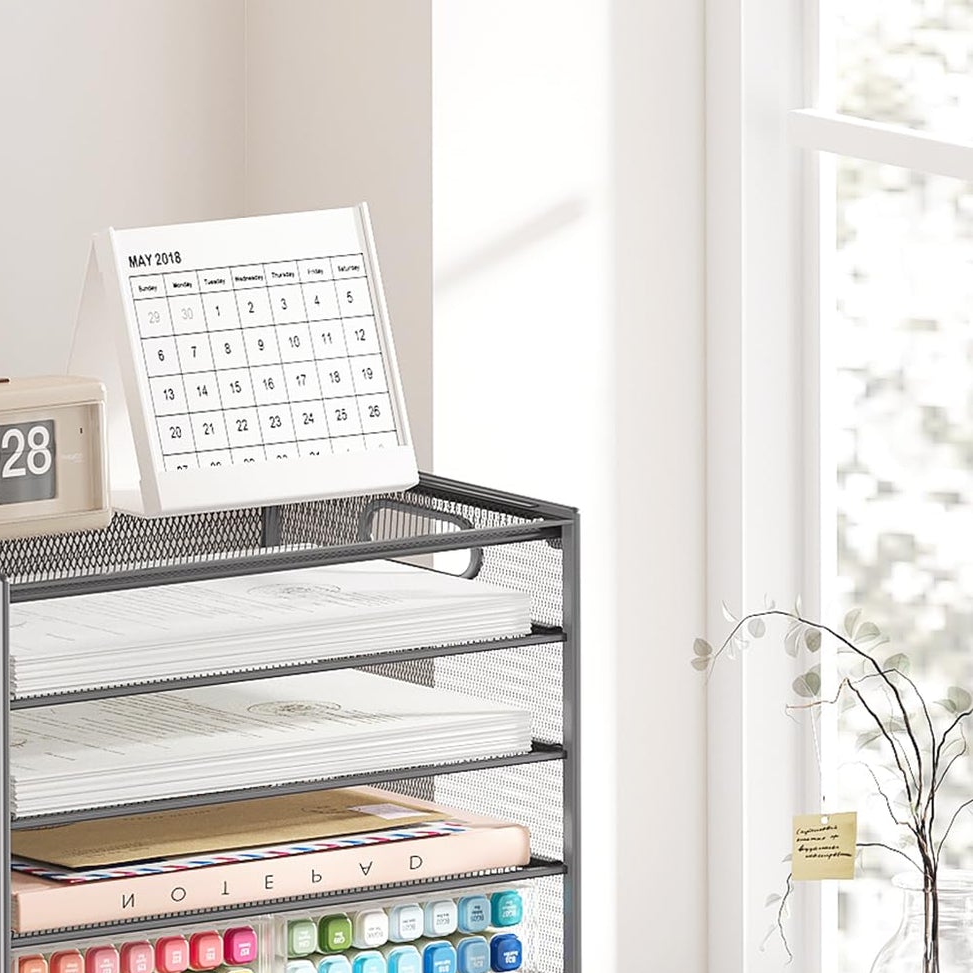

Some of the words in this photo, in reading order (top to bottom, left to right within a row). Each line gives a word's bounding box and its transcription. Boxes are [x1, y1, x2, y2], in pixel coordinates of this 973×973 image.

[128, 254, 152, 268] MAY
[154, 251, 182, 266] 2018
[147, 310, 161, 324] 29
[180, 307, 194, 320] 30
[214, 304, 221, 317] 1
[247, 300, 256, 314] 2
[280, 297, 289, 311] 3
[313, 295, 321, 306] 4
[346, 290, 355, 304] 5
[157, 349, 166, 362] 6
[190, 345, 198, 358] 7
[223, 342, 232, 355] 8
[257, 338, 265, 352] 9
[288, 335, 301, 349] 10
[320, 332, 333, 345] 11
[353, 328, 367, 342] 12
[162, 387, 176, 401] 13
[196, 384, 209, 398] 14
[229, 380, 243, 394] 15
[262, 377, 276, 391] 16
[295, 373, 308, 387] 17
[328, 370, 342, 384] 18
[361, 367, 374, 381] 19
[168, 425, 183, 439] 20
[202, 422, 216, 436] 21
[235, 418, 250, 432] 22
[268, 414, 283, 429] 23
[301, 412, 316, 426] 24
[334, 408, 349, 422] 25
[367, 404, 382, 419] 26
[1, 425, 52, 478] 28
